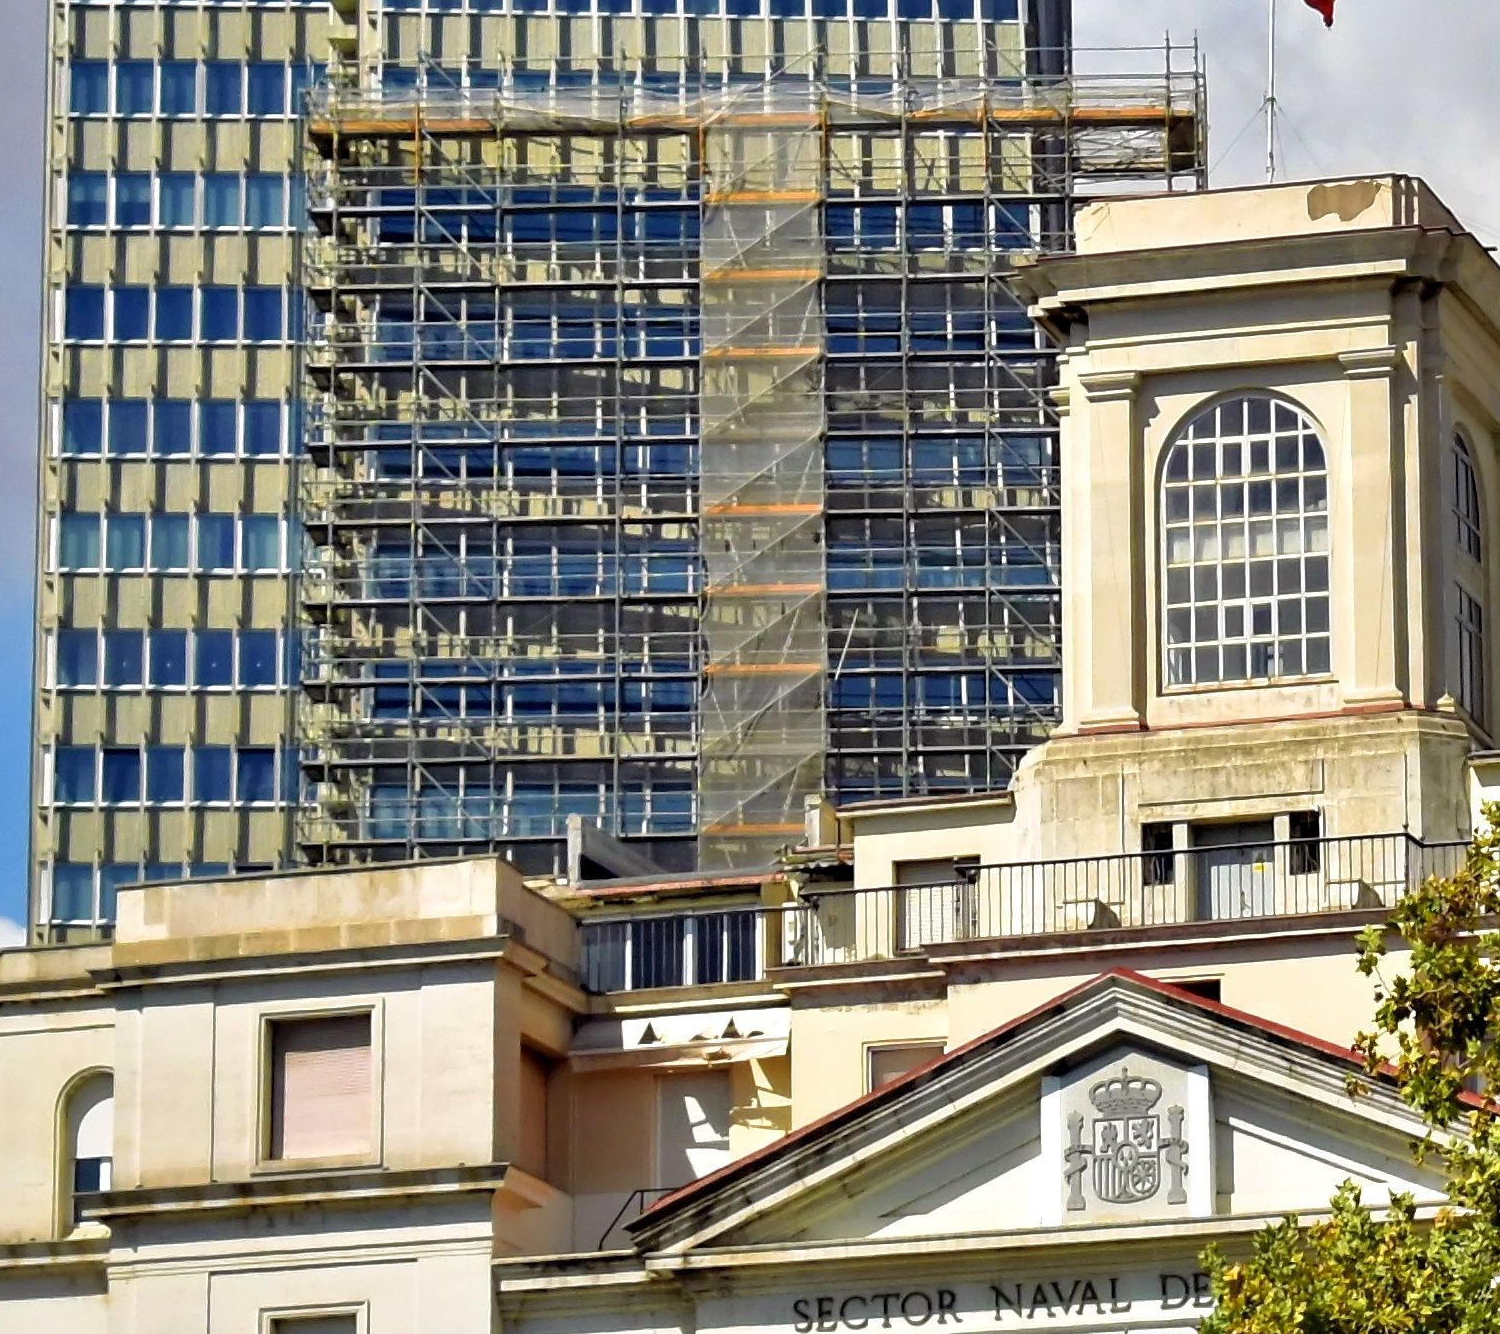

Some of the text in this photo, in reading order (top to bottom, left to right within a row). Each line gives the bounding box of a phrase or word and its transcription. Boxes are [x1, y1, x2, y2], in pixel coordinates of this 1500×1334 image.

[793, 1273, 1216, 1334] SECTOR NAVAL DE
